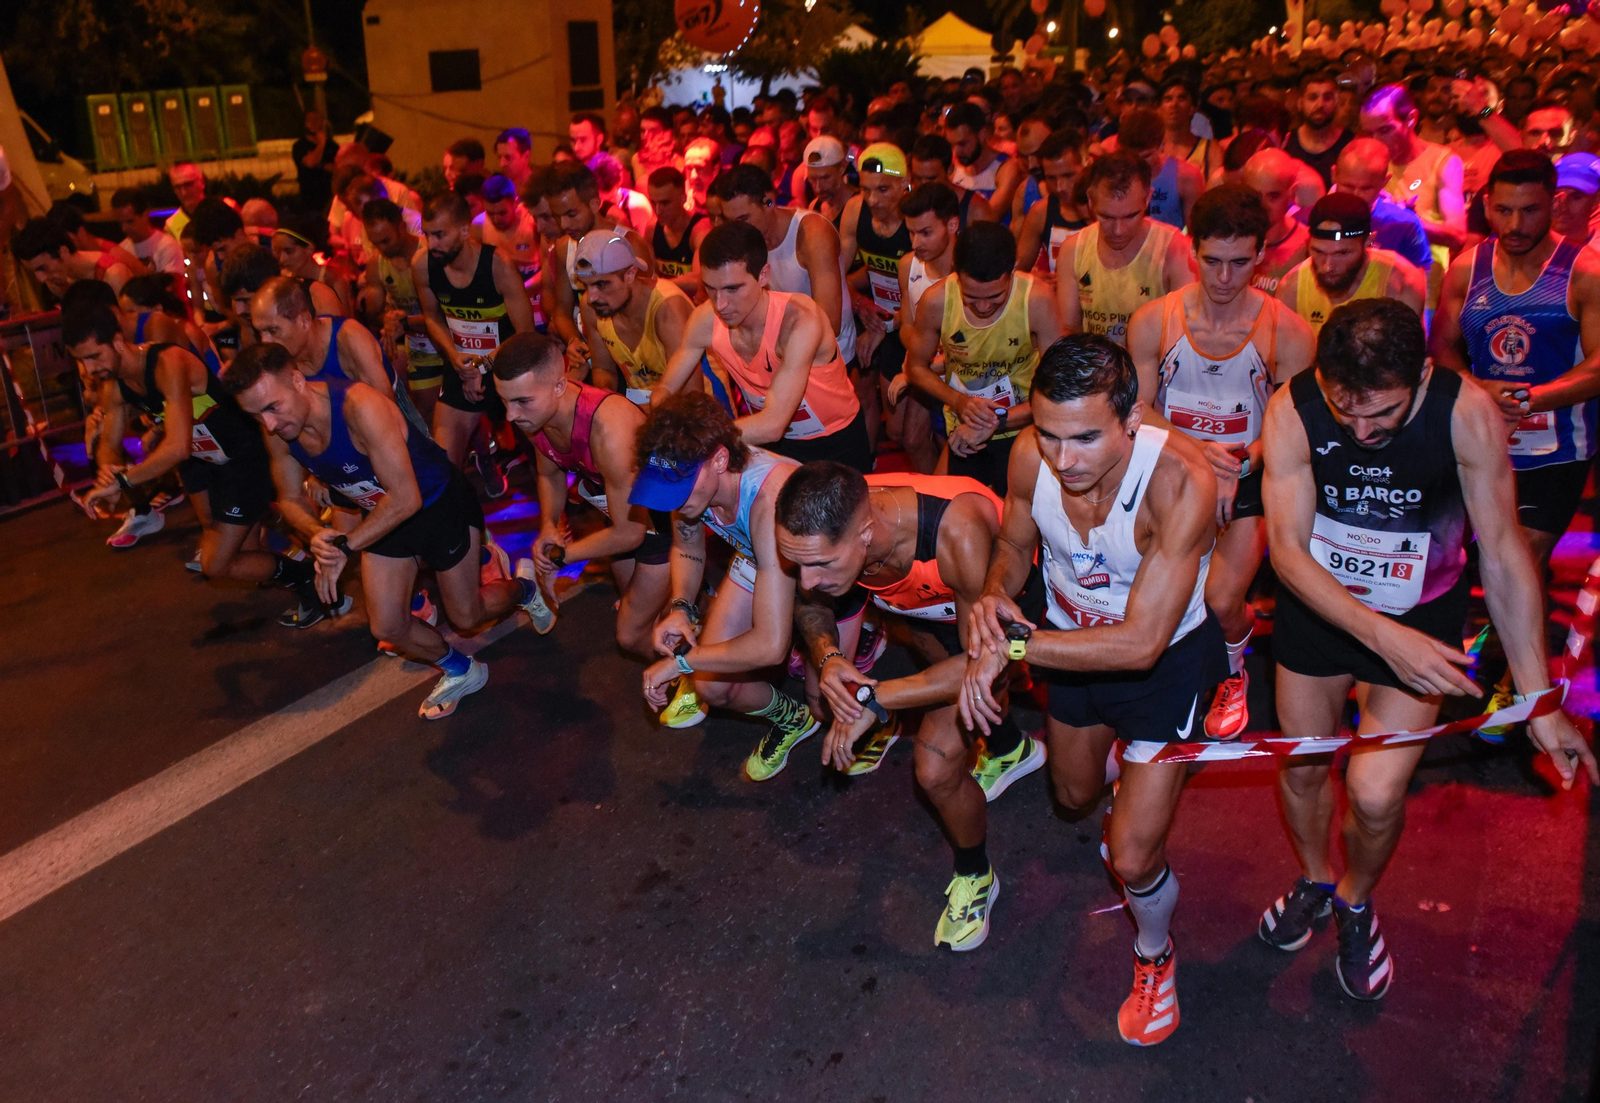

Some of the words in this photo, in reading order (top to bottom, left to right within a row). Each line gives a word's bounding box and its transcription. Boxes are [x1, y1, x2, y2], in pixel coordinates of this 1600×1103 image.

[461, 338, 482, 348] 210
[1192, 417, 1226, 434] 223
[1345, 485, 1422, 504] BARCO
[1329, 552, 1390, 578] 9621
